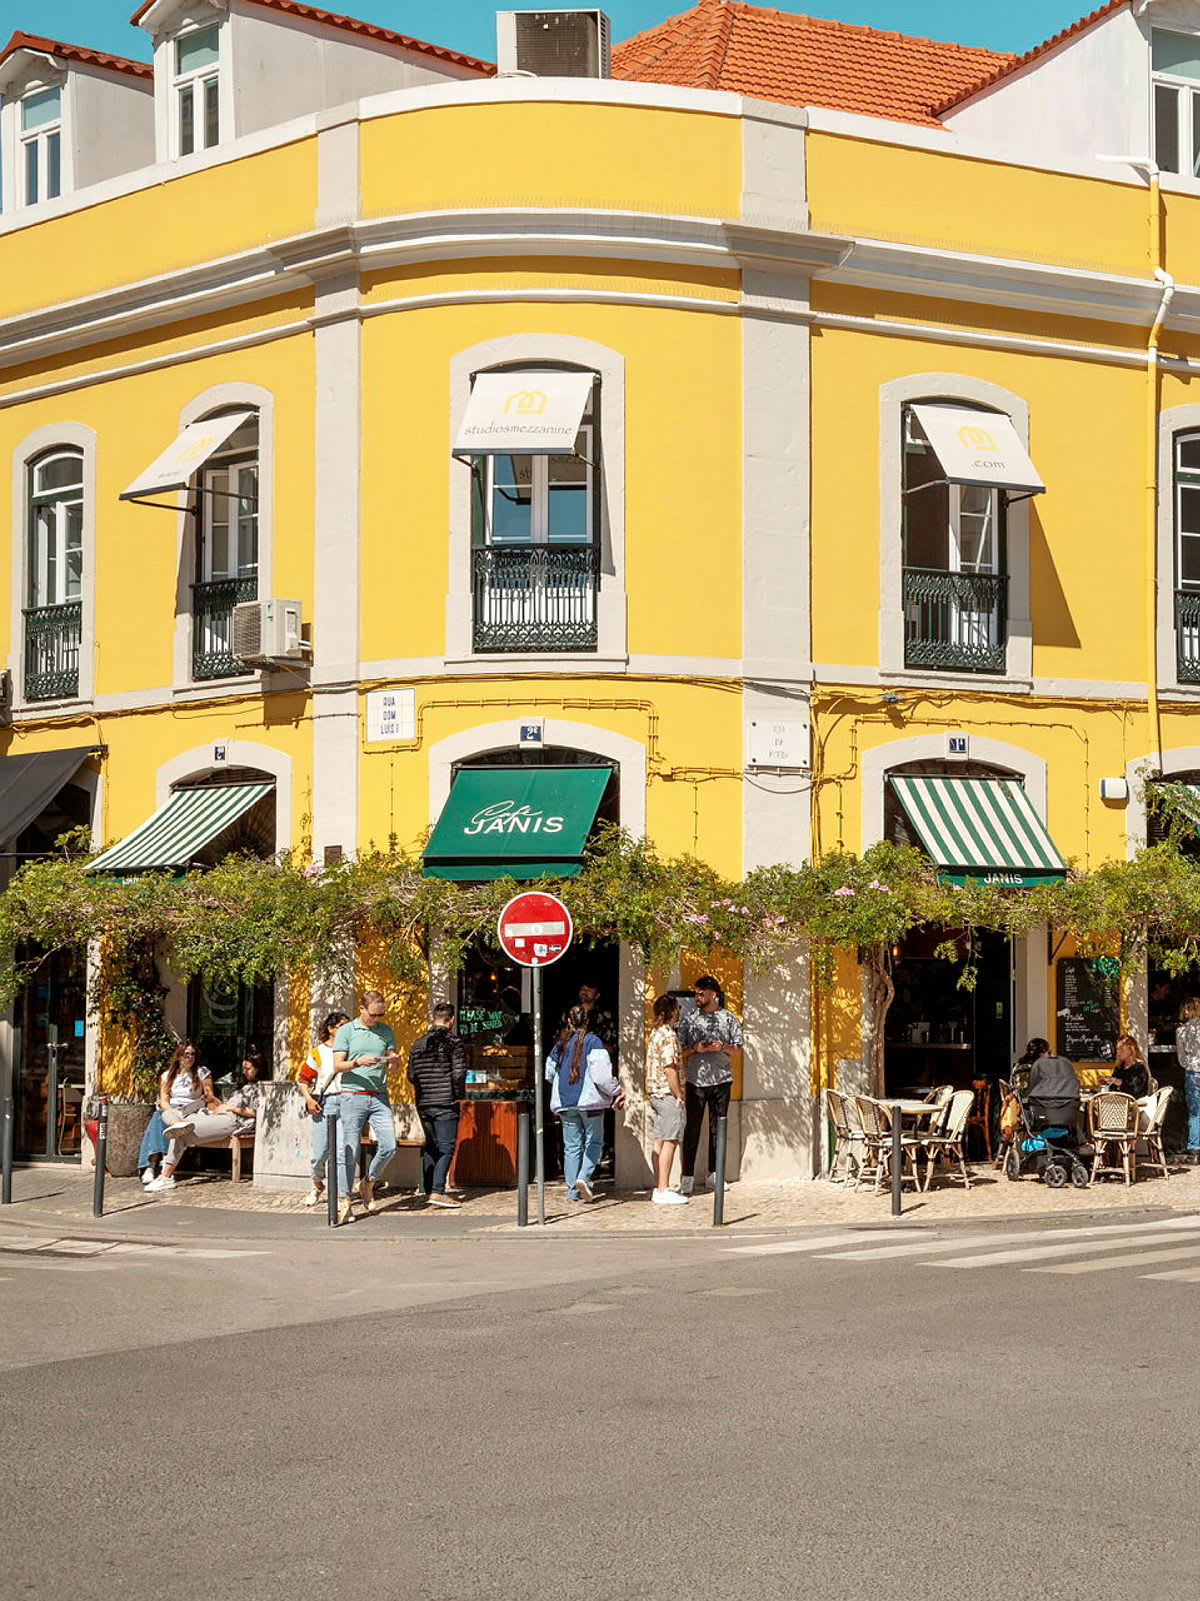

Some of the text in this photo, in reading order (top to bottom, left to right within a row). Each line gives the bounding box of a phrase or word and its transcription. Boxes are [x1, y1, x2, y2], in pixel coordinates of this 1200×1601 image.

[464, 420, 572, 435] studiosmezzanine
[463, 816, 565, 835] JANIS
[983, 872, 1023, 884] JANIS
